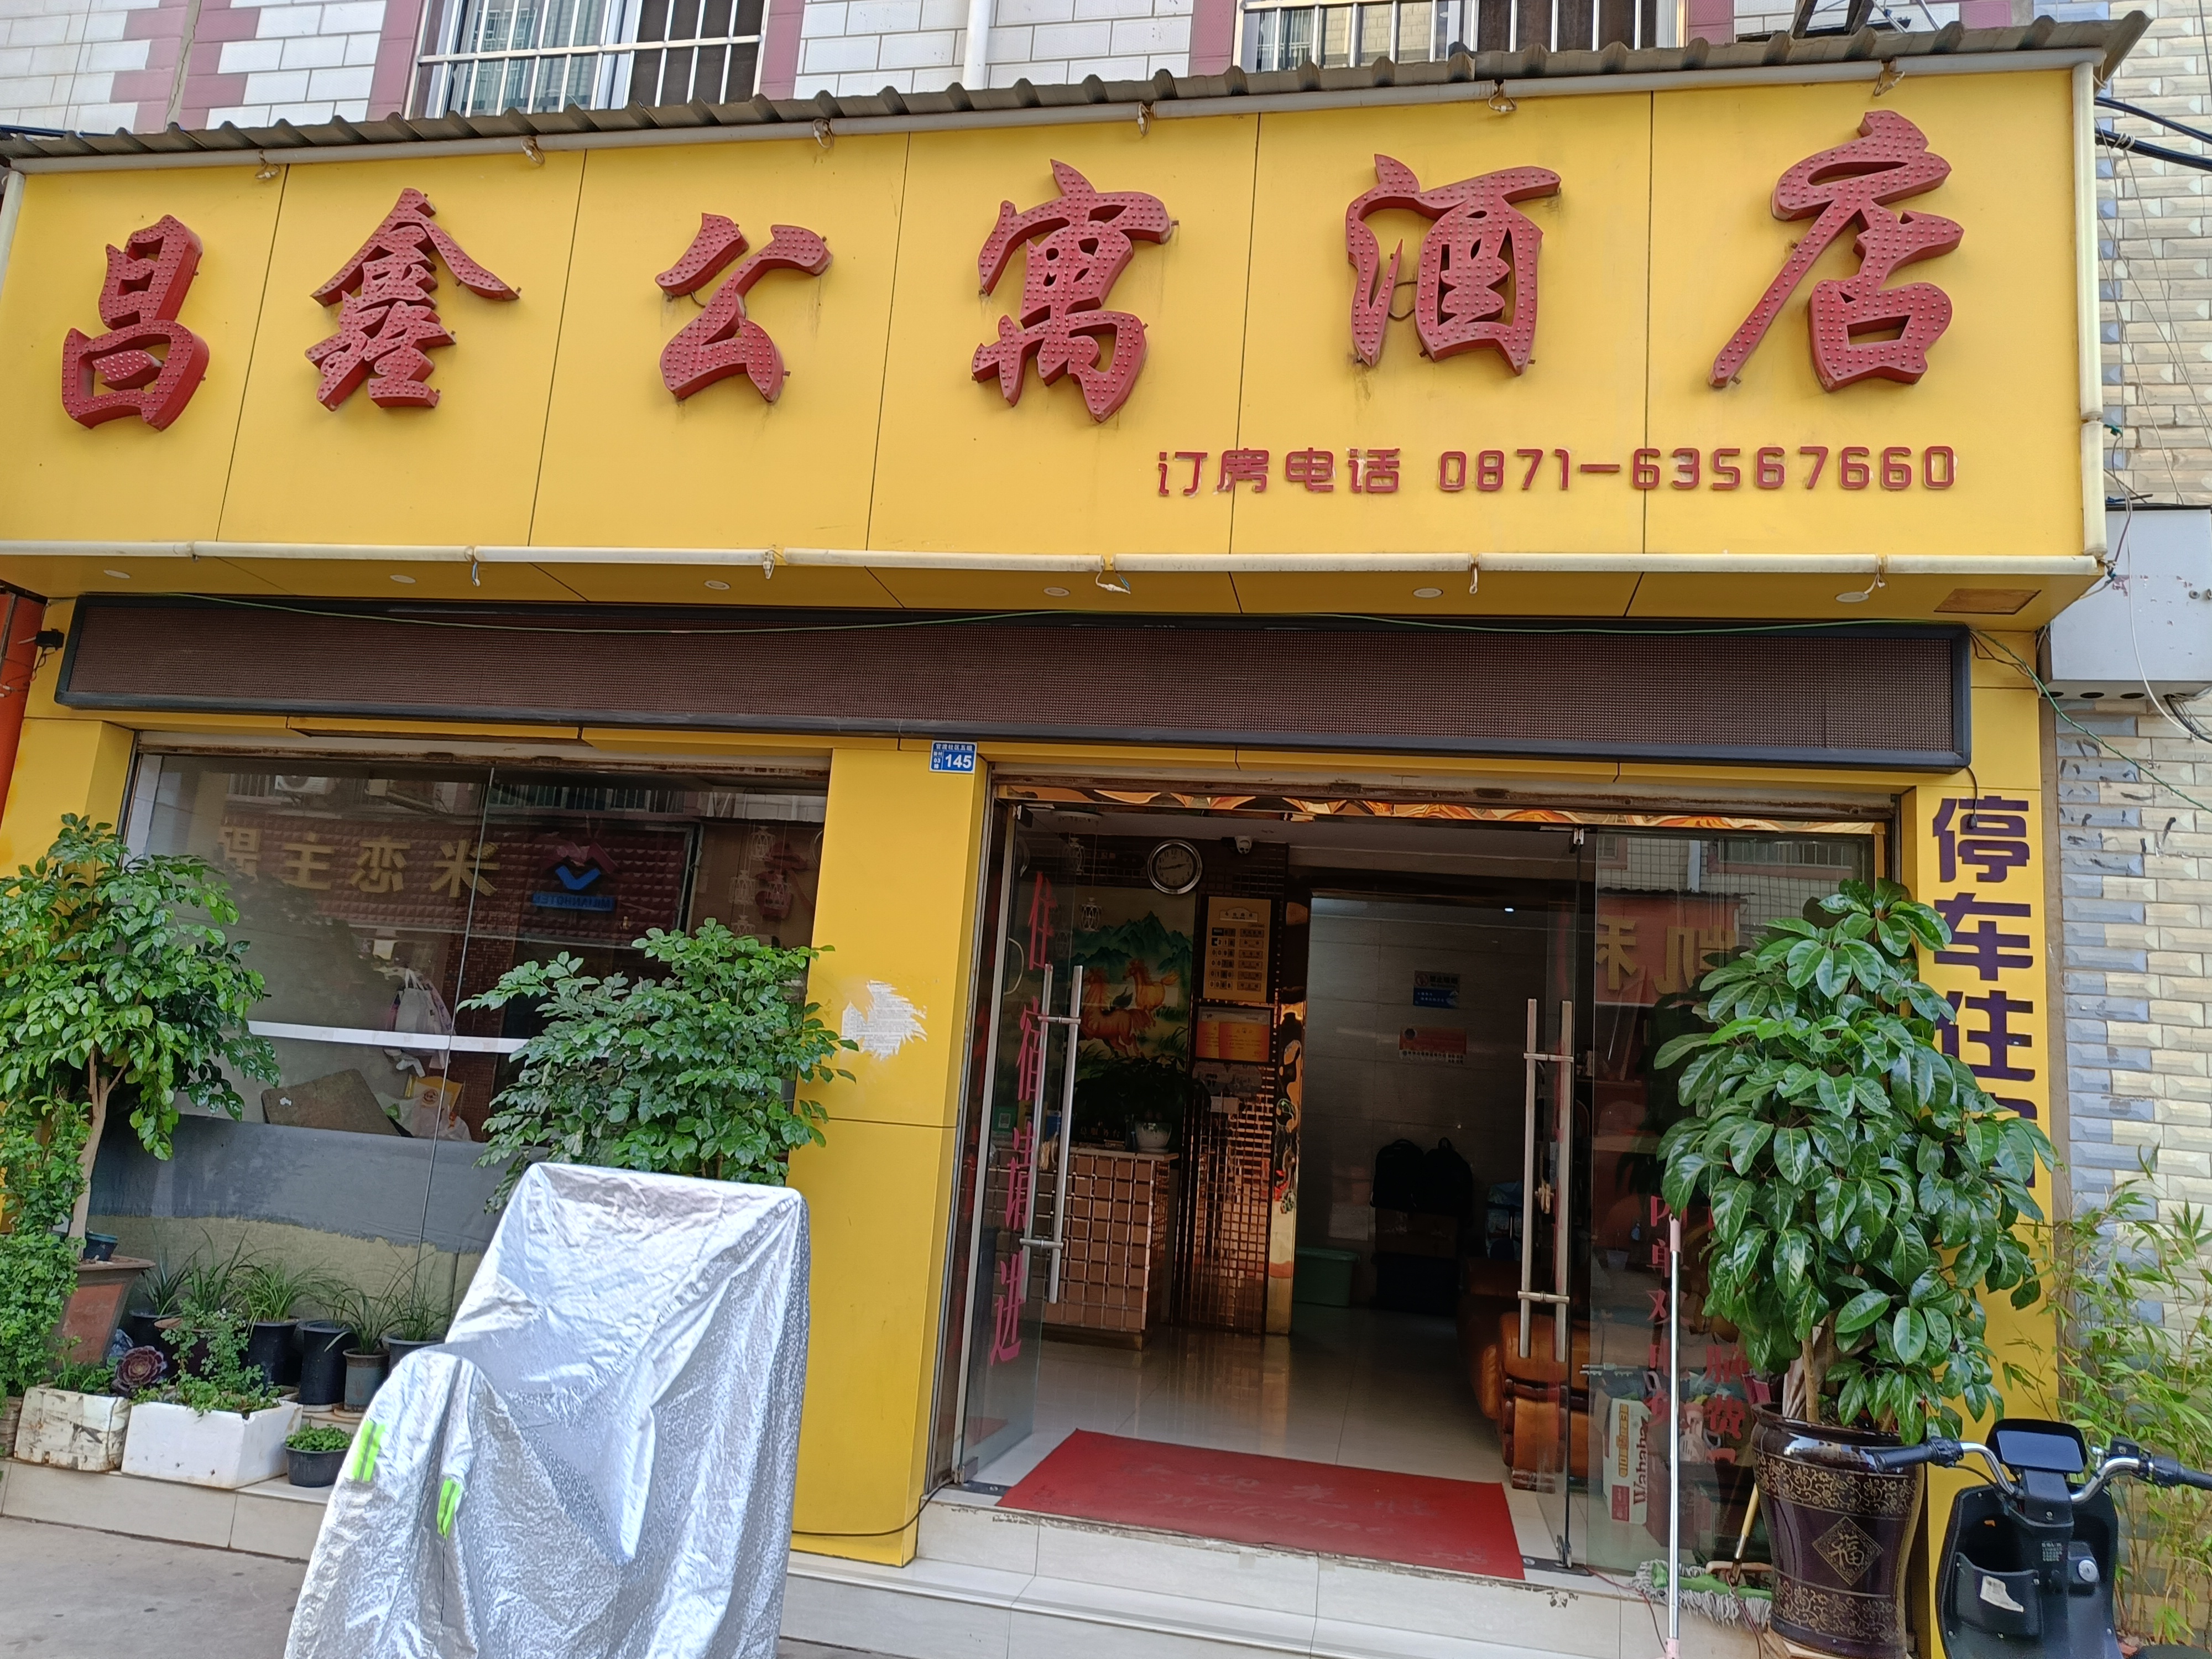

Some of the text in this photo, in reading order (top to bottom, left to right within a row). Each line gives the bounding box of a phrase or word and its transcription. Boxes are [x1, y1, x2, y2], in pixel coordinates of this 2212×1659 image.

[61, 109, 1965, 432] 昌鑫公寓酒店
[1158, 447, 1401, 496] 订房电话
[945, 754, 972, 769] 145
[1932, 795, 2038, 1188] 停车住
[992, 872, 1055, 1364] 住宿请进
[1828, 1530, 1865, 1571] 福
